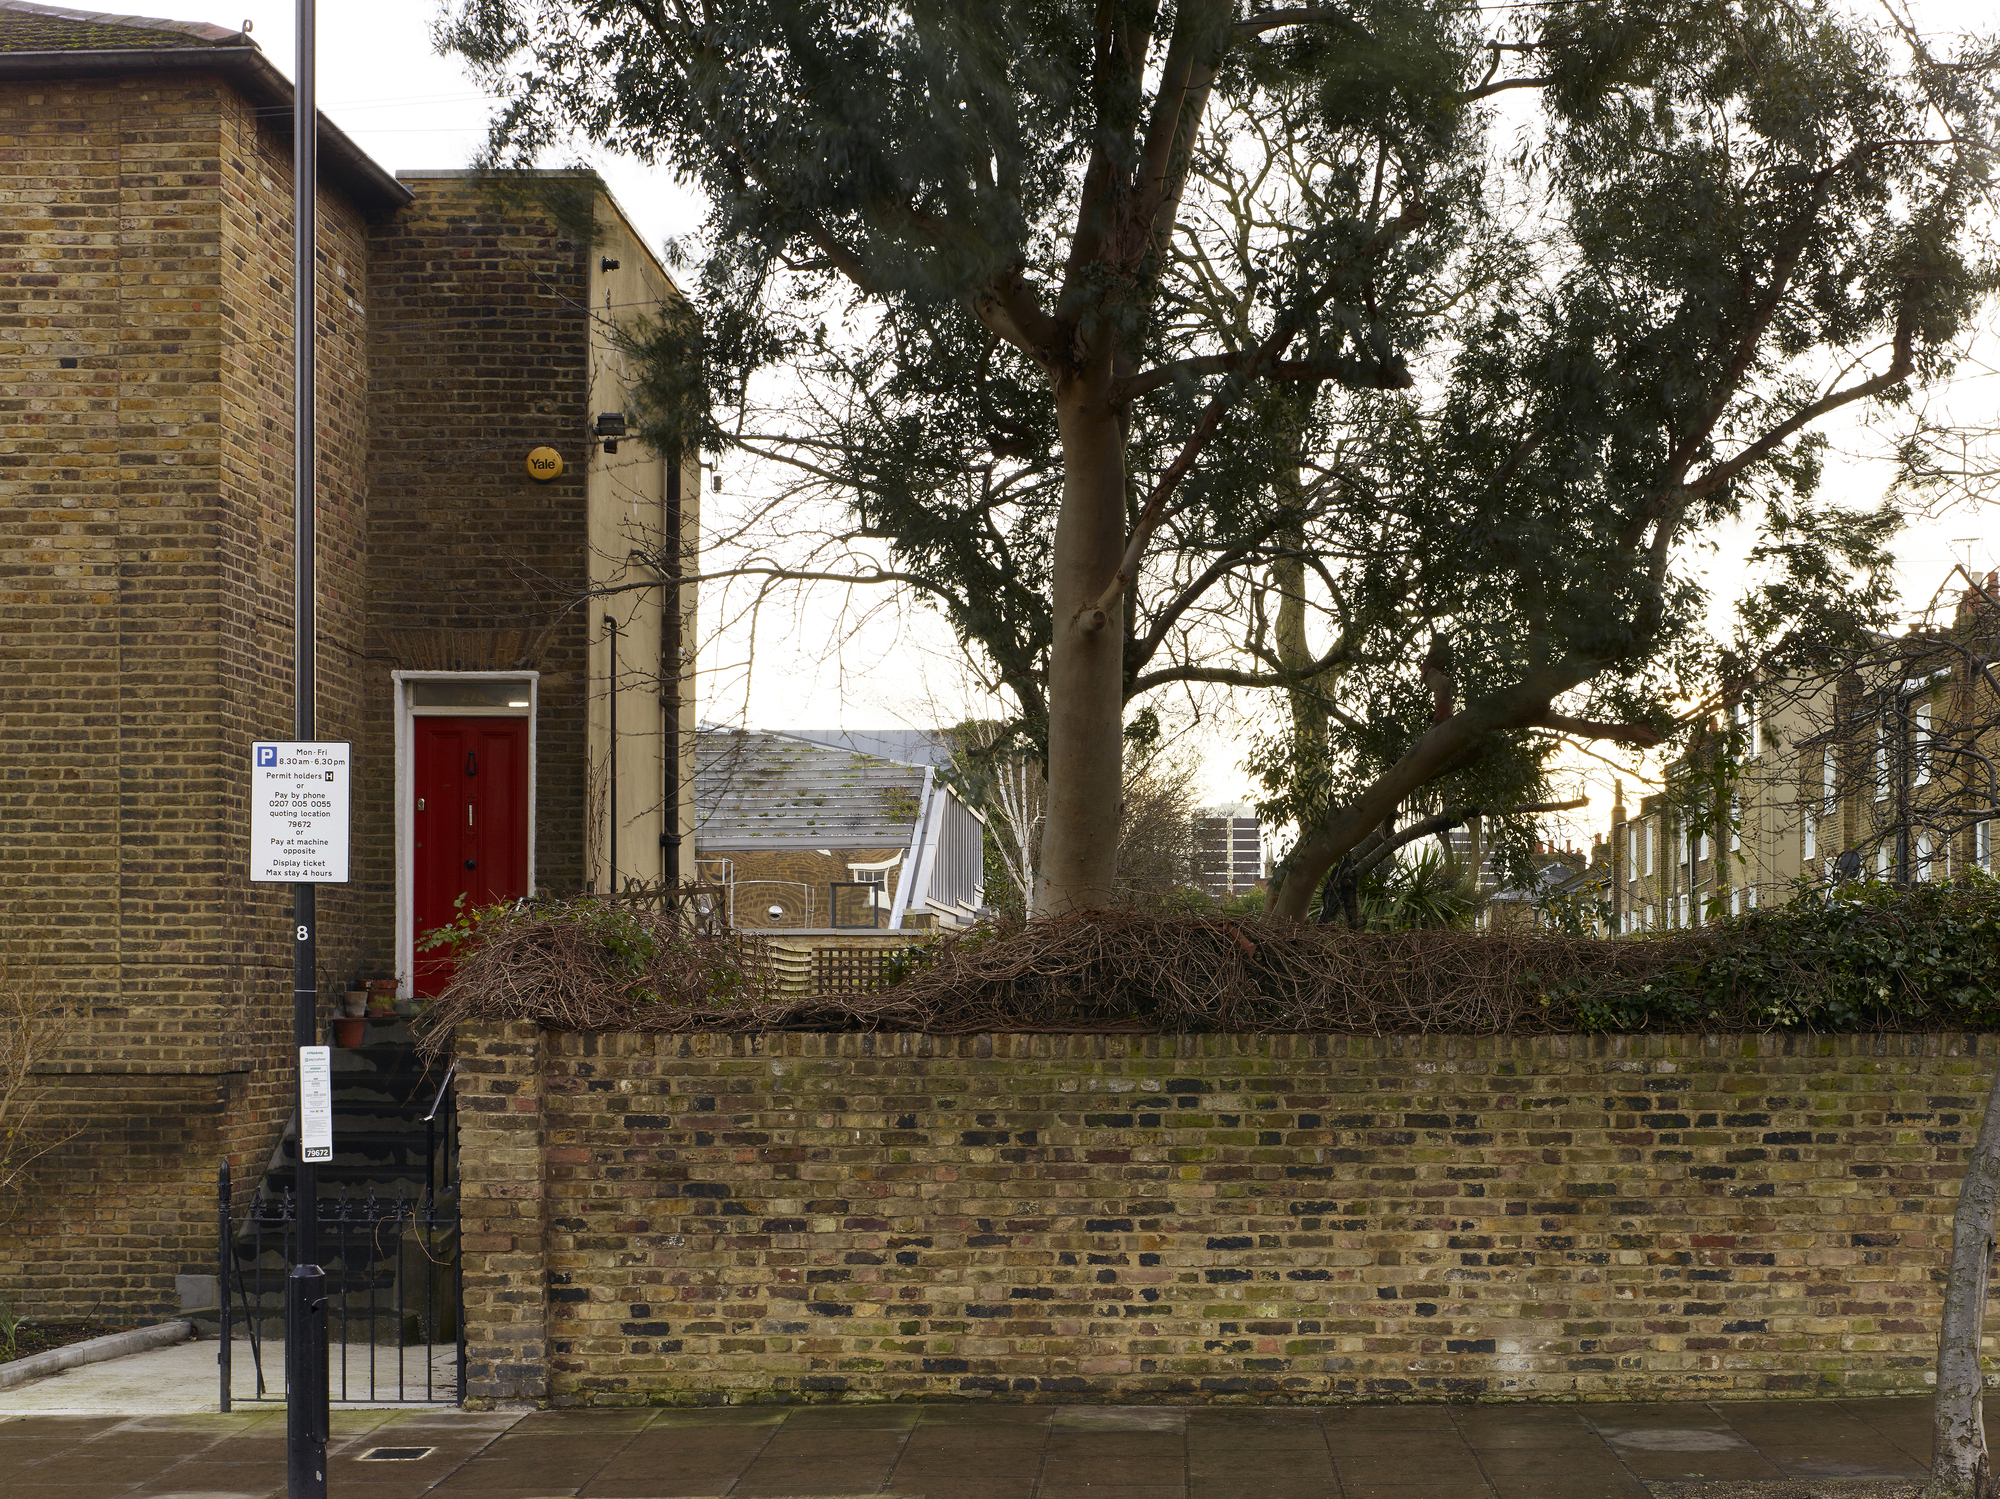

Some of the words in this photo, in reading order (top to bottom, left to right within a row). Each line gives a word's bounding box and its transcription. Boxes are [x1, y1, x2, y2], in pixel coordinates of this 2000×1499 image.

[530, 458, 555, 470] Yale
[261, 748, 273, 765] P
[325, 772, 333, 781] H
[275, 791, 288, 799] Pay
[291, 792, 300, 800] by
[270, 810, 297, 818] quoting
[271, 838, 284, 846] Pay
[273, 859, 301, 868] Display
[296, 924, 309, 941] 8
[307, 1149, 329, 1157] 79672
